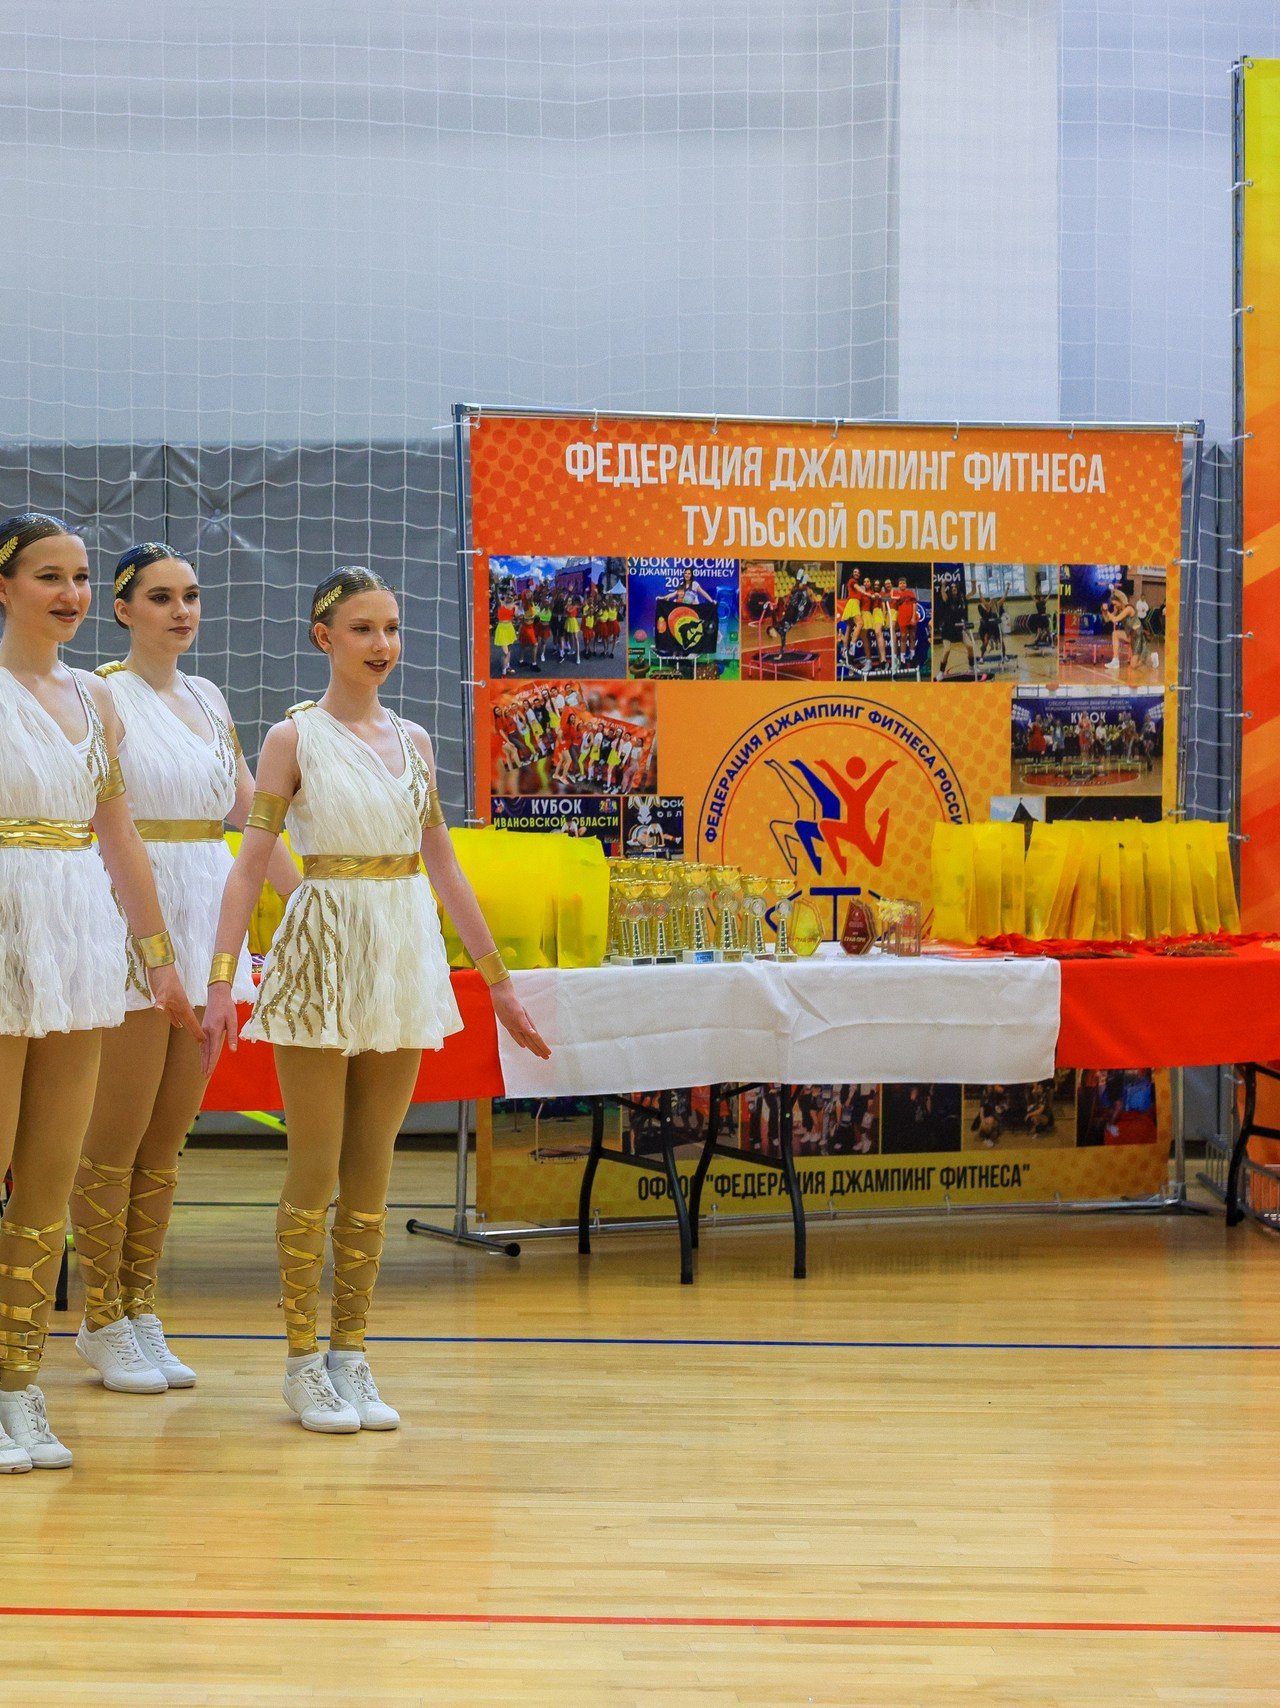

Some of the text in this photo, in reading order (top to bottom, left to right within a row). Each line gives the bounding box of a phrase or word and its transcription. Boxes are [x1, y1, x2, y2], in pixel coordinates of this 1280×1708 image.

[565, 441, 1106, 493] ФЕДЕРАЦИЯ ДЖАМПИНГ ФИТНЕСА
[682, 502, 996, 551] ТУЛЬСКОЙ ОБЛАСТИ
[674, 557, 735, 569] РОССИИ
[639, 568, 686, 577] ДЖАМПИН
[693, 569, 734, 578] ФИТНЕСУ
[665, 577, 685, 588] 202
[705, 734, 763, 843] ФЕДЕРАЦИЯ
[766, 704, 865, 741] ДЖАМПИНГ
[868, 710, 936, 769] ФИТНЕСА
[531, 799, 581, 814] КУБОК
[657, 810, 682, 818] ОБЛ
[493, 815, 619, 828] ИВАНОВСКОЙ ОБЛАСТИ
[706, 1171, 825, 1199] "ФЕДЕРАИЯ
[830, 1167, 935, 1196] ДЖАМПИНГ
[940, 1163, 1030, 1190] ФИТНЕСА"
